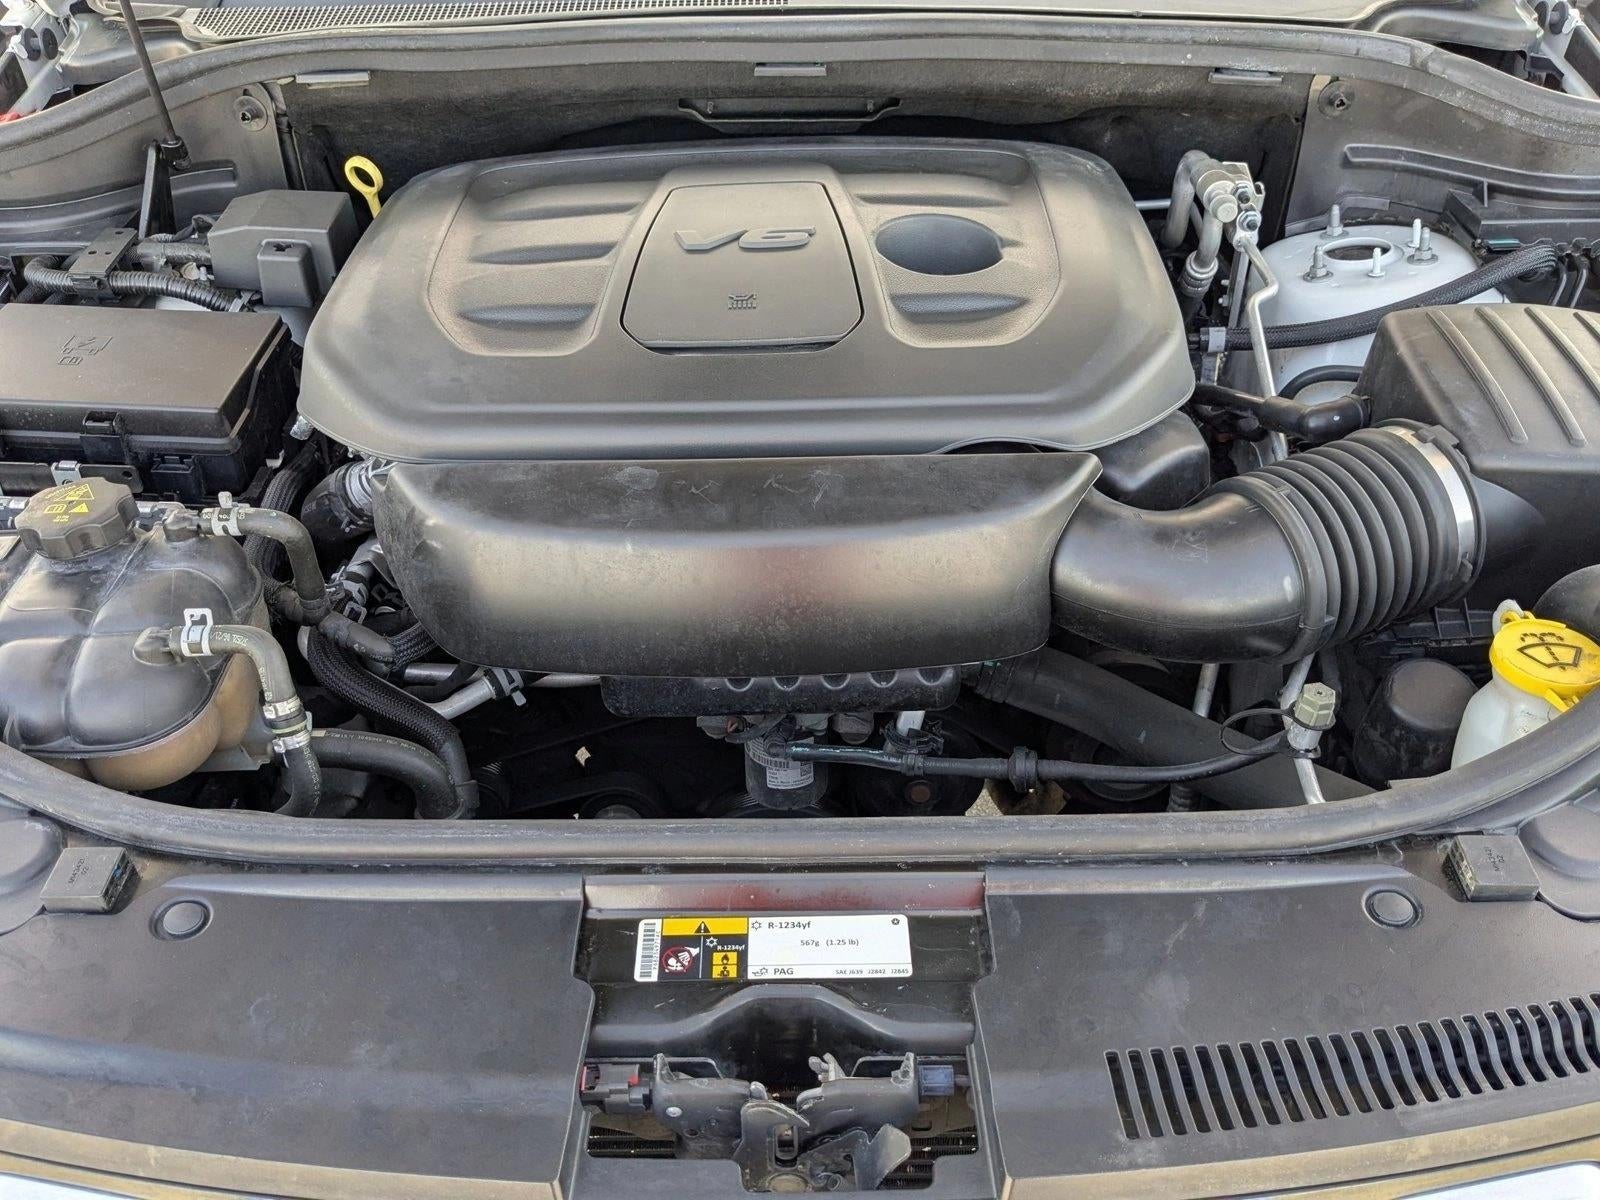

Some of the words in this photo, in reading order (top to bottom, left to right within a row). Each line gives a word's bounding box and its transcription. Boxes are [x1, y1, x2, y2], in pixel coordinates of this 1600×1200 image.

[674, 226, 816, 251] V6
[768, 921, 811, 930] R-1234yf
[800, 939, 820, 947] 567g
[826, 939, 846, 947] (1.25
[849, 938, 860, 947] lb)
[773, 967, 794, 975] PAG
